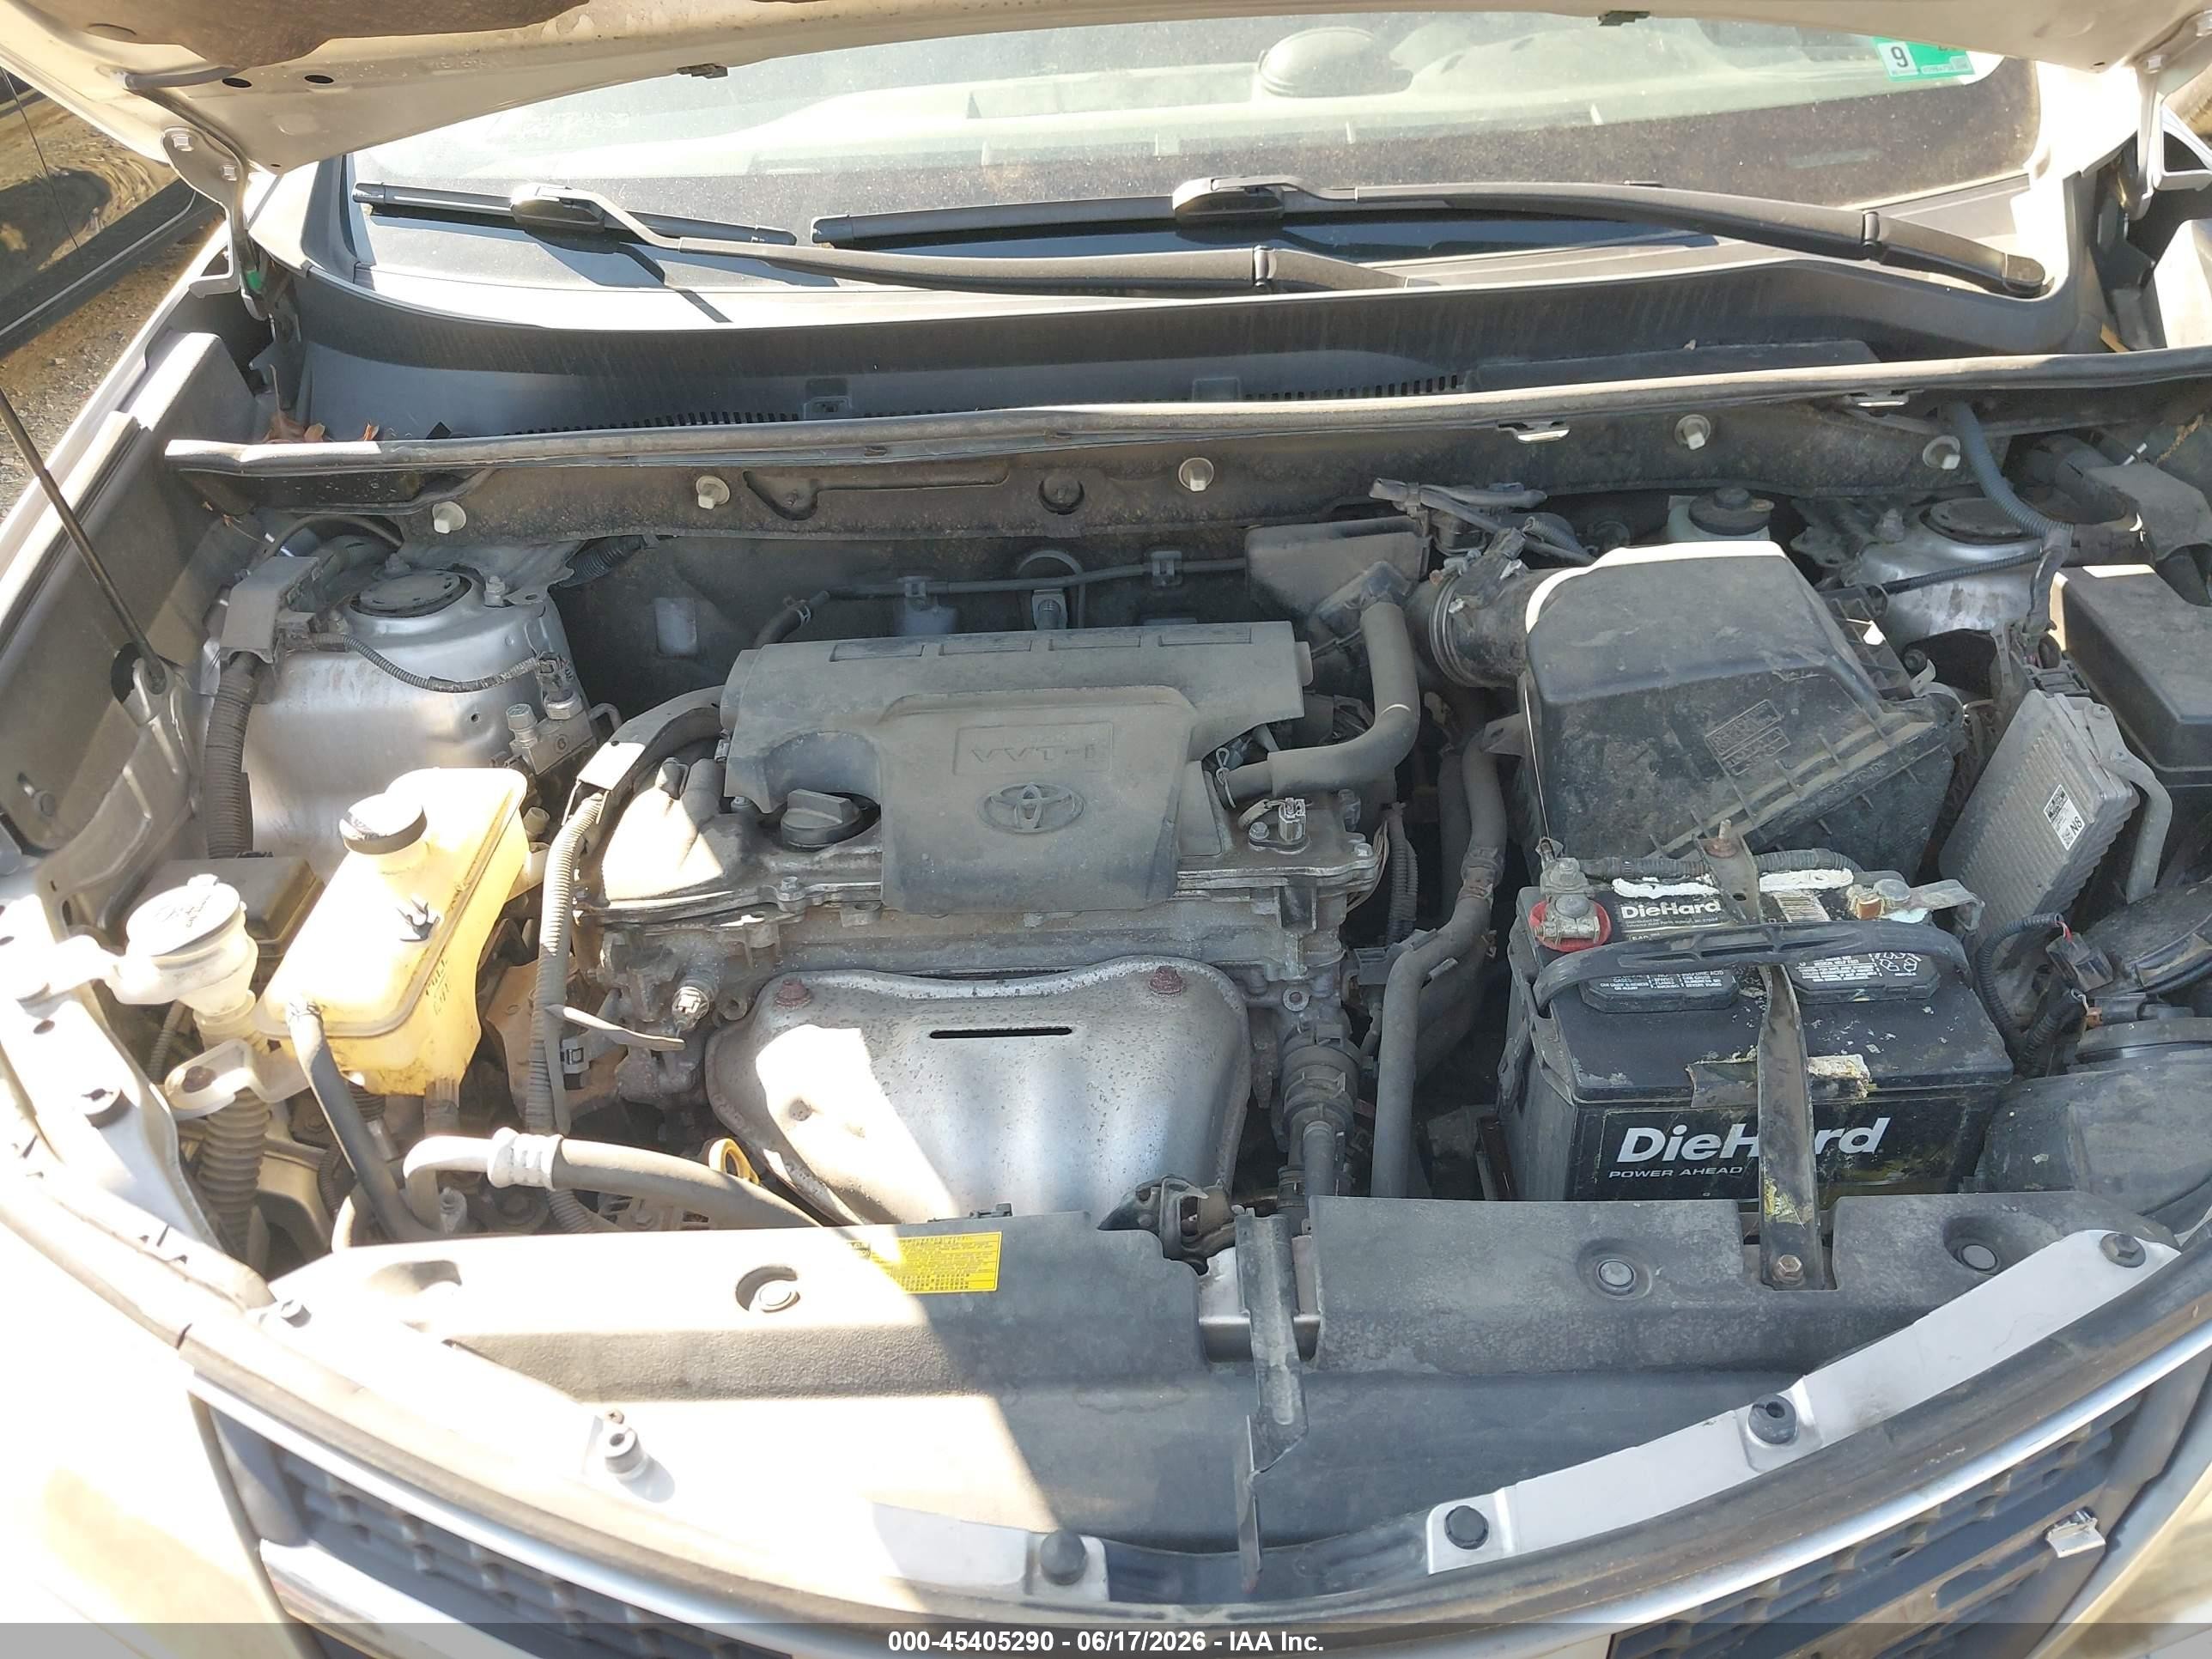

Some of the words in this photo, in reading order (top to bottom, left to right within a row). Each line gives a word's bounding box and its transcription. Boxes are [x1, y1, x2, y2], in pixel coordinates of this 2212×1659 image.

[1890, 46, 1909, 68] 9
[2070, 816, 2083, 836] N8
[1620, 901, 1722, 919] DieHard
[1616, 1117, 1891, 1163] DieHrd
[1608, 1170, 1674, 1179] POWER
[1679, 1166, 1744, 1176] AHEAD
